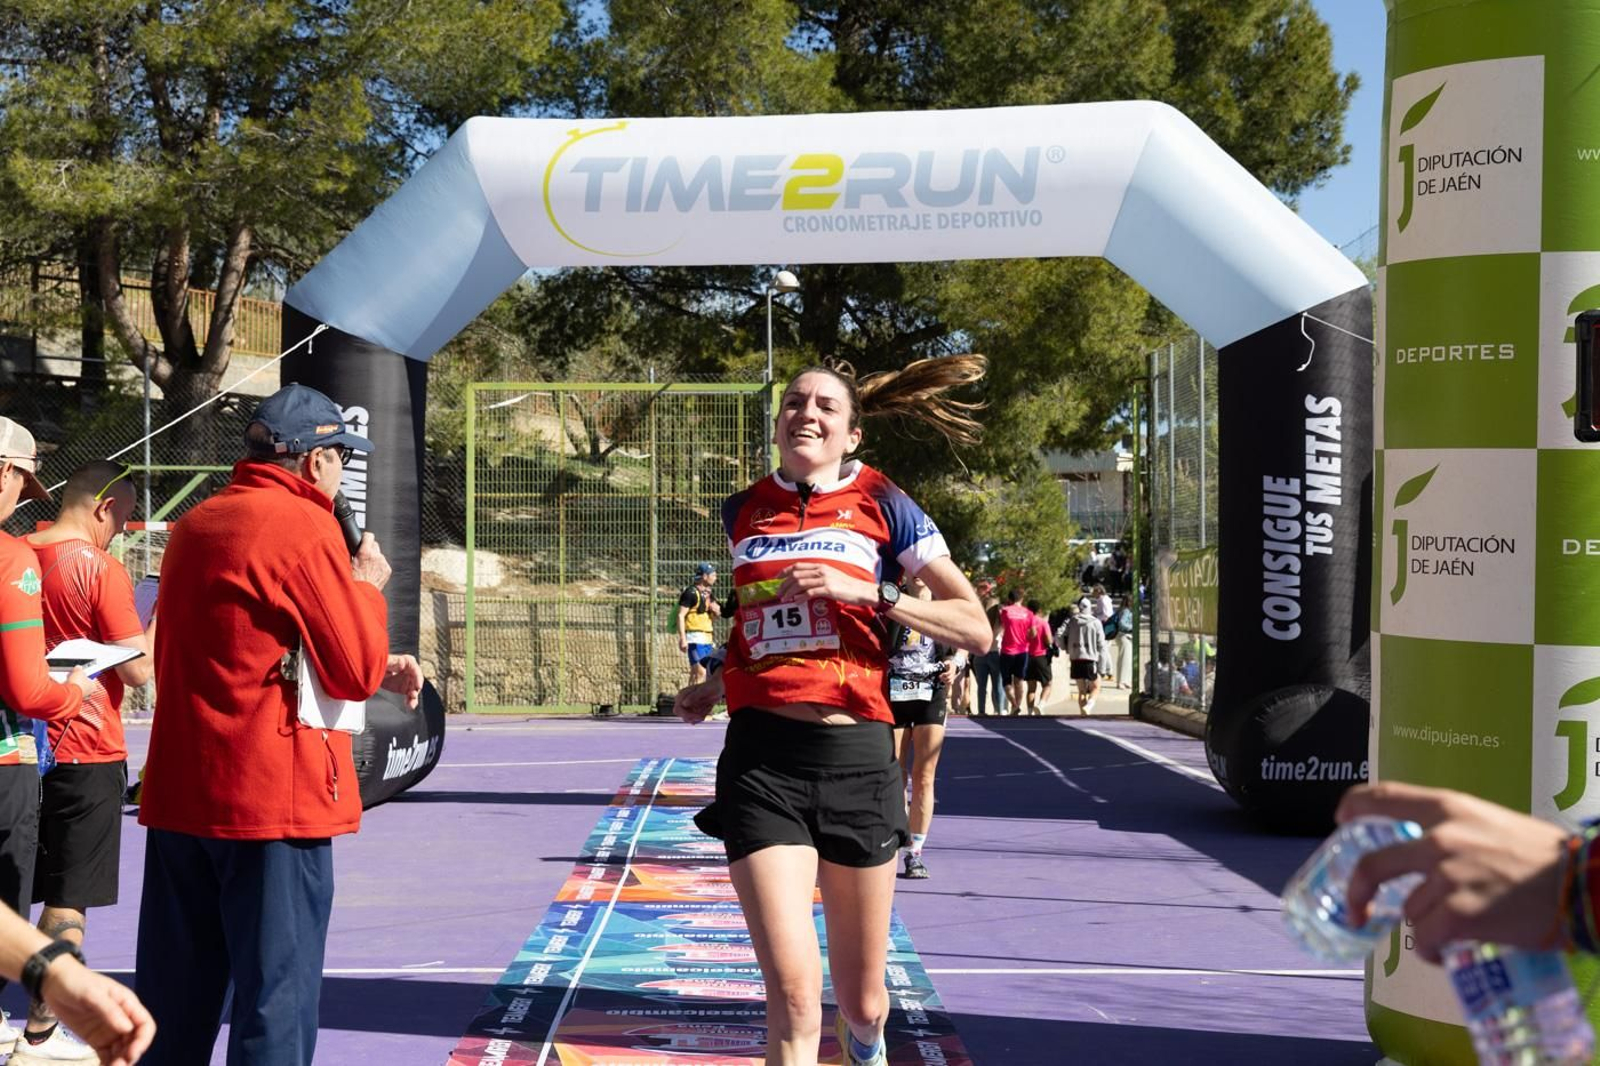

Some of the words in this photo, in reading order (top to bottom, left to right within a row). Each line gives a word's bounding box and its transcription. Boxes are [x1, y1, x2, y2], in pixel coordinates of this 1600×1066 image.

[1418, 145, 1522, 172] DIPUTACIÓN
[569, 146, 1041, 213] TIME2RUN
[1417, 180, 1436, 195] DE
[1438, 172, 1481, 194] JAÉN
[783, 213, 931, 233] CRONOMETRAJE
[936, 209, 1043, 230] DEPORTIVO
[1397, 344, 1515, 363] DEPORTES
[1304, 394, 1343, 506] METAS
[1305, 511, 1334, 556] TUS
[1411, 533, 1516, 555] DIPUTACIÓN
[771, 537, 846, 555] Avanza
[1262, 475, 1302, 641] CONSIGUE
[1411, 559, 1430, 574] DE
[1432, 557, 1475, 576] JAÉN
[771, 607, 802, 629] 15
[902, 681, 920, 690] 631
[1392, 722, 1500, 750] www.dipujaen.es
[1261, 755, 1369, 780] time2run.e
